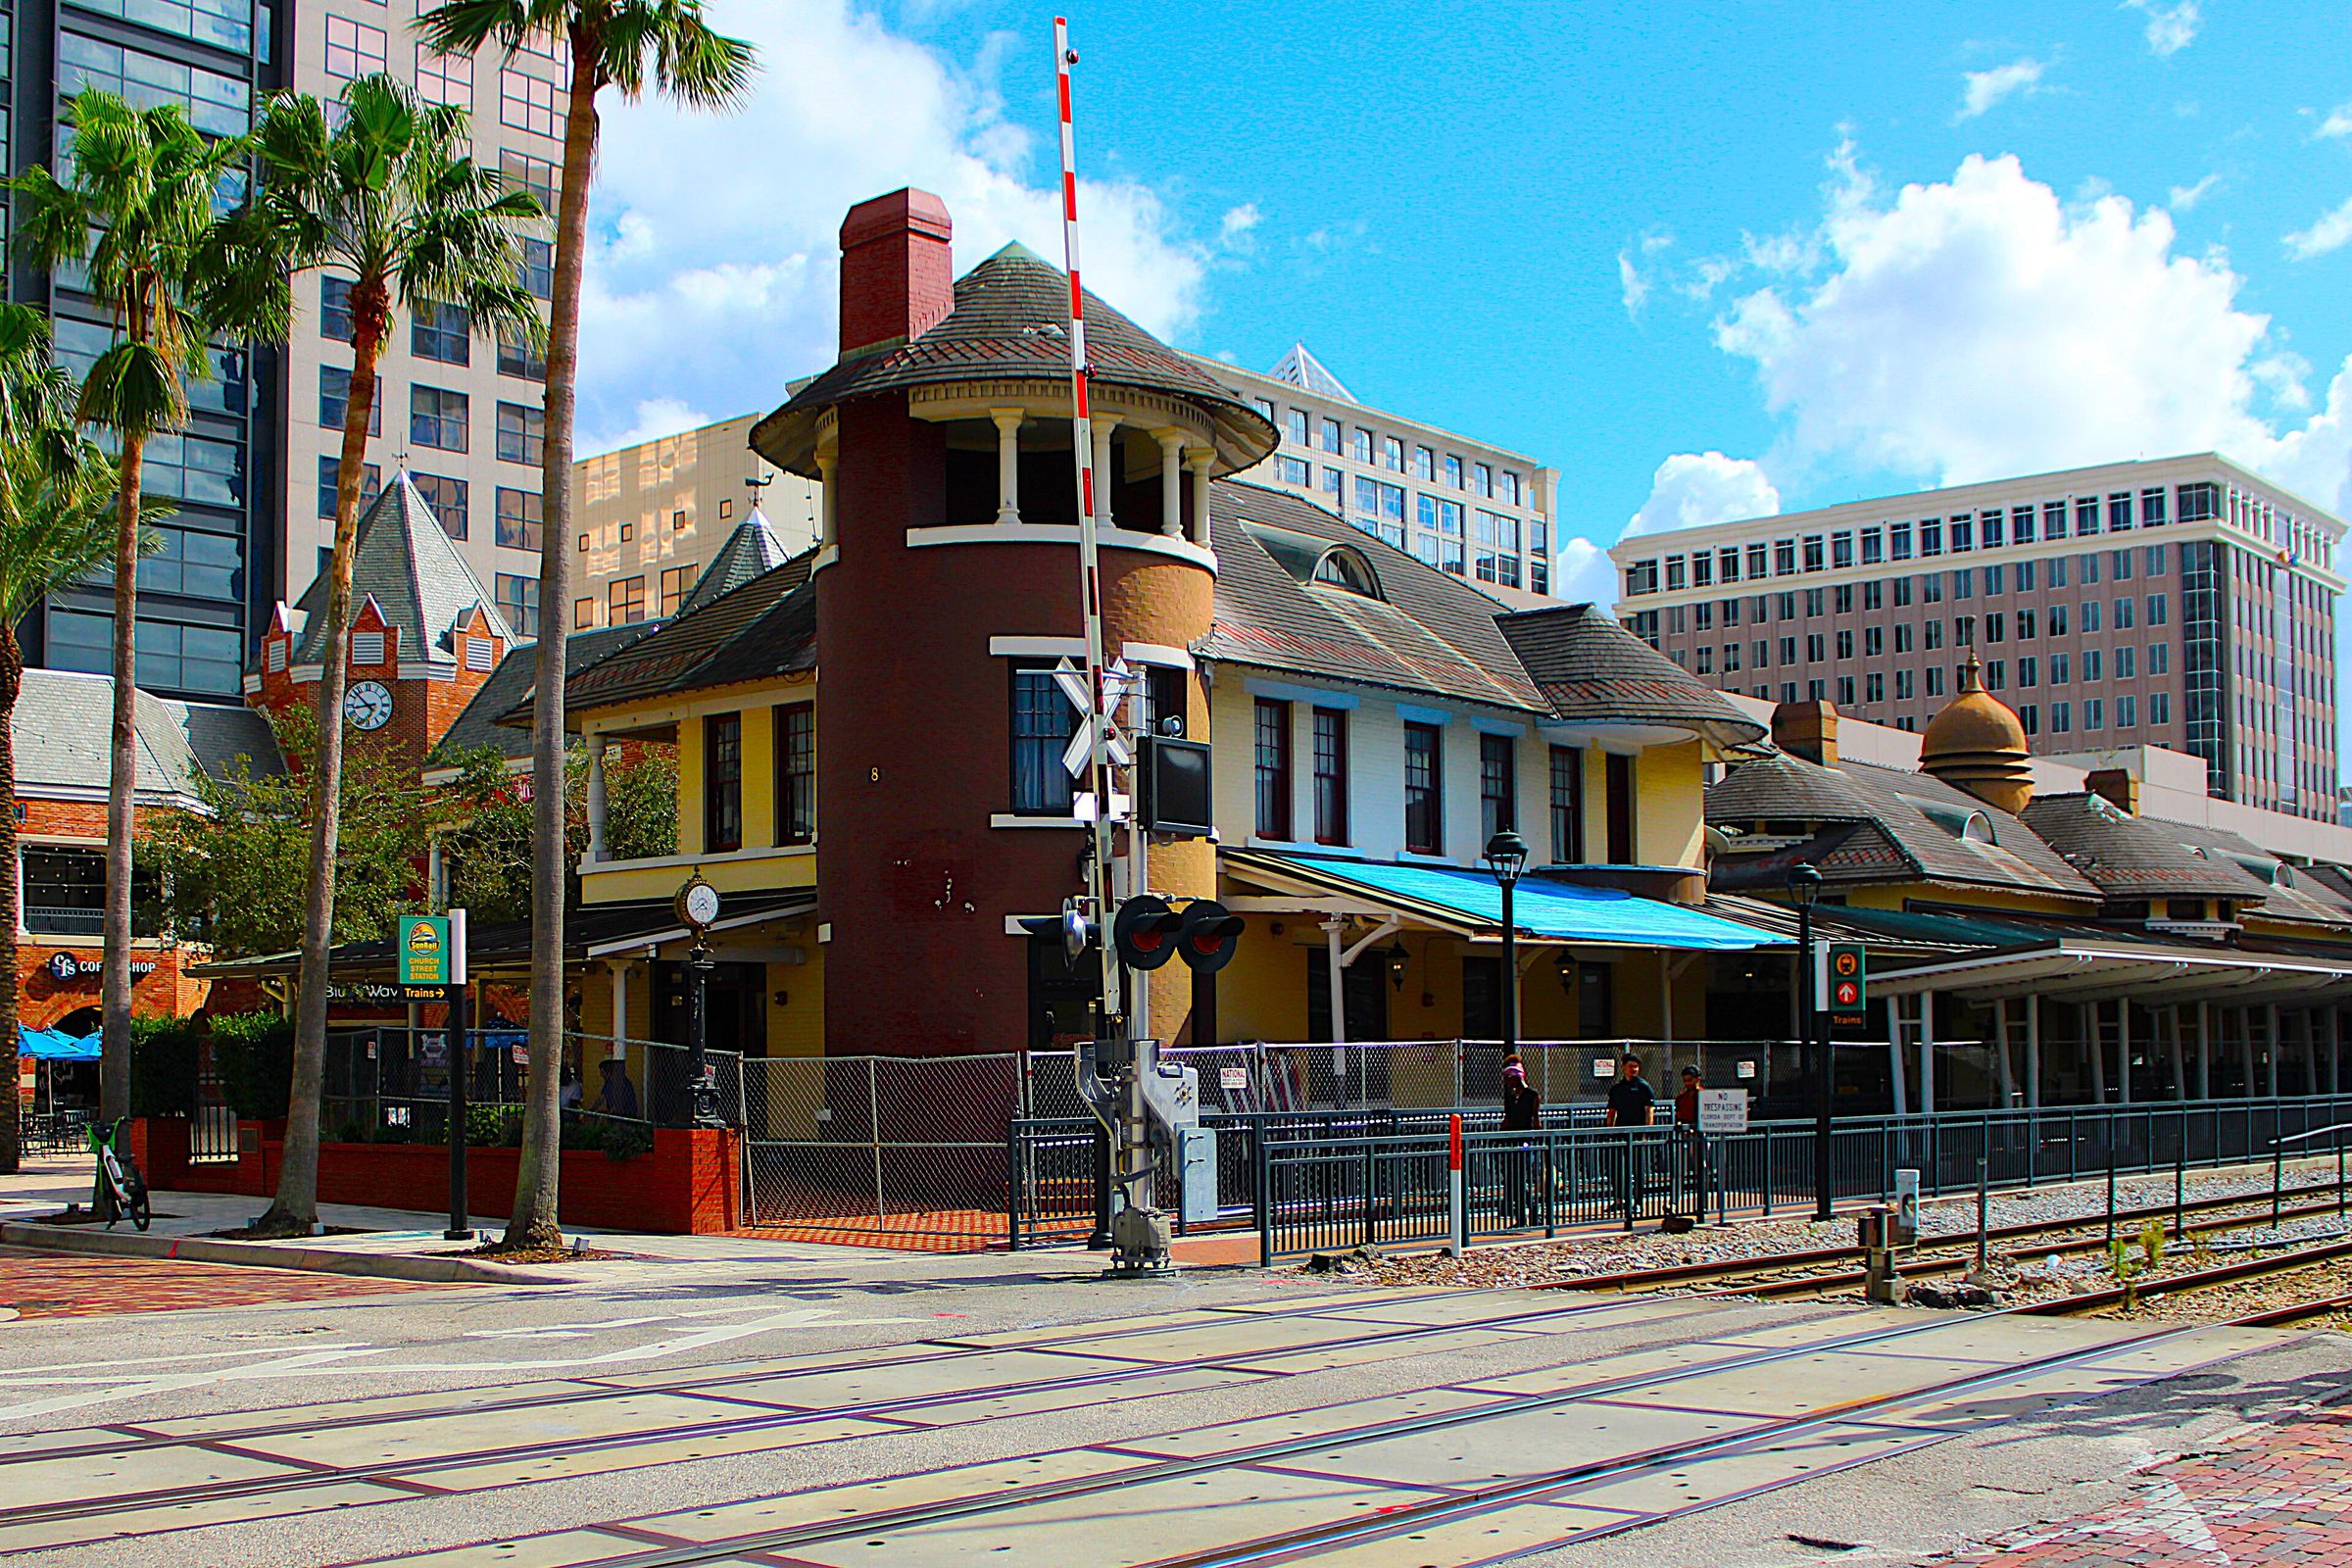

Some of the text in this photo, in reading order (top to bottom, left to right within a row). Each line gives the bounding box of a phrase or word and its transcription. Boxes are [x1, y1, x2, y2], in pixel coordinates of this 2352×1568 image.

[871, 767, 878, 781] 8
[326, 985, 398, 998] Blu Wav
[405, 988, 434, 998] Trains
[1834, 1015, 1862, 1024] Trains
